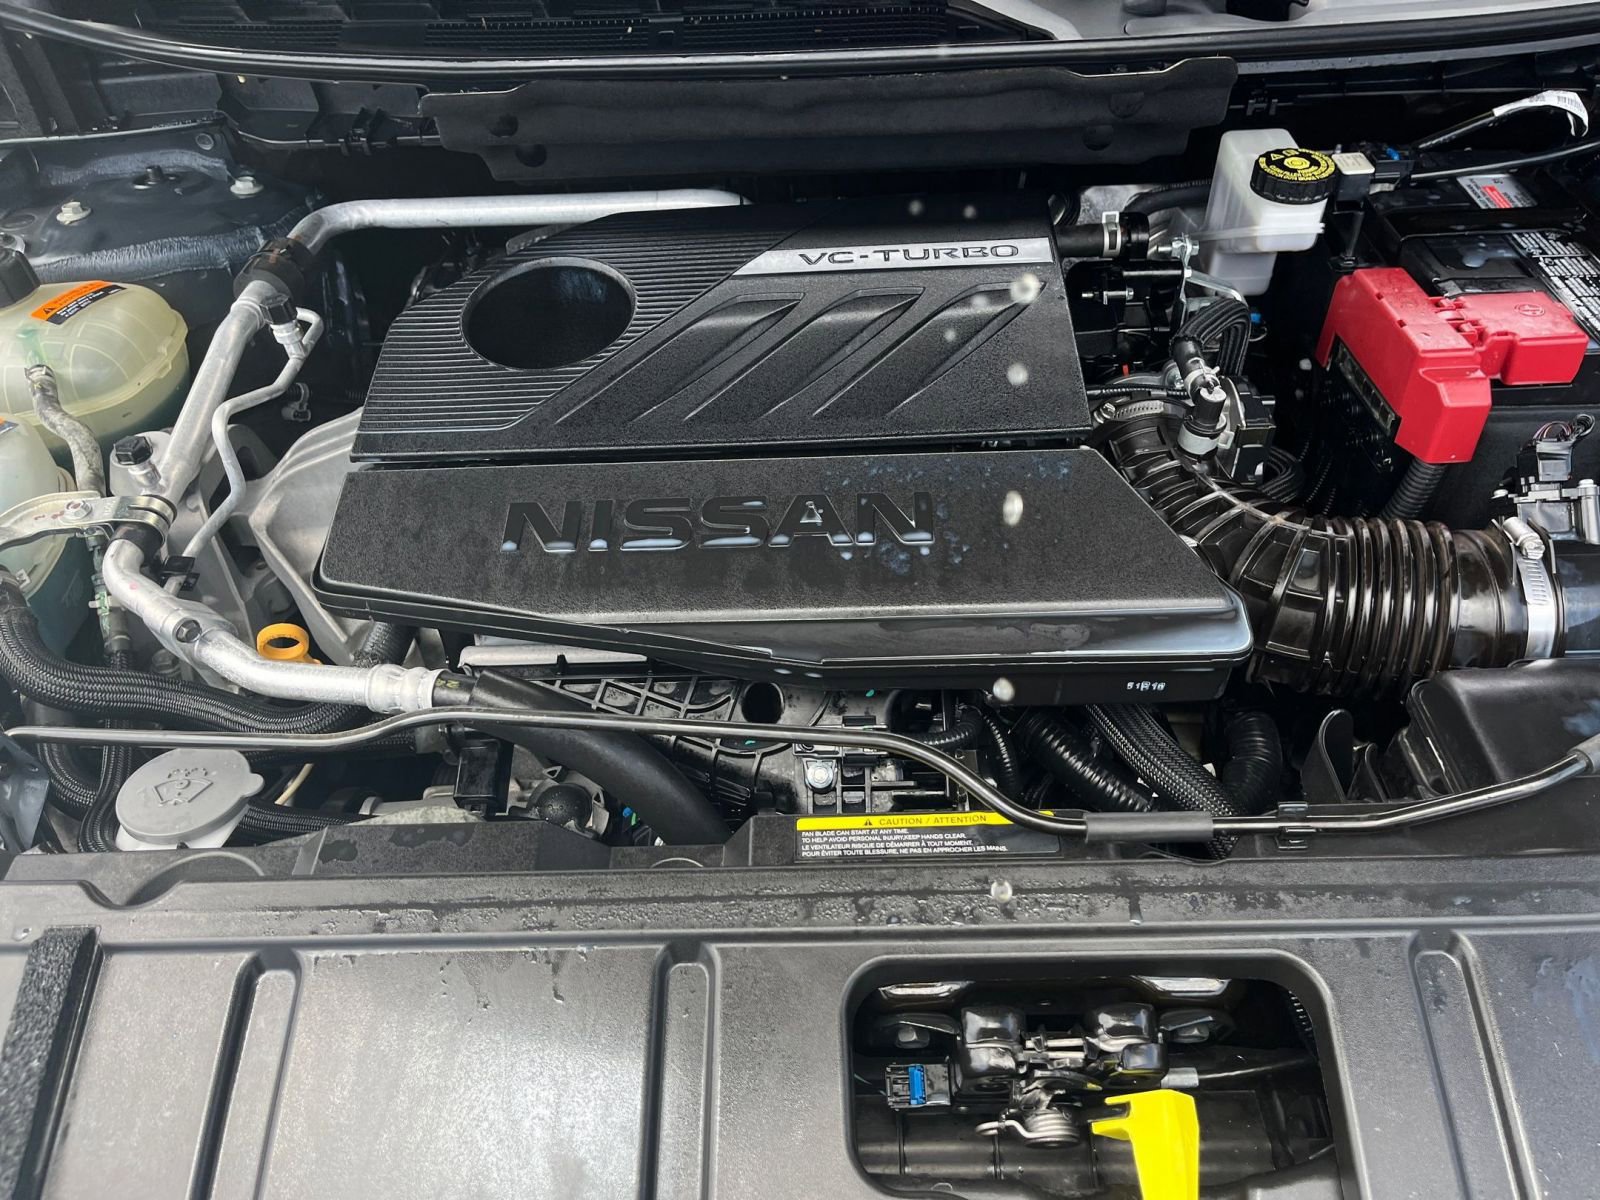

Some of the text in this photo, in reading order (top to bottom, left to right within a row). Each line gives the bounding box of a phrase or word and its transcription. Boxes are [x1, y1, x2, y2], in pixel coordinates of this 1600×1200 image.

[798, 244, 1020, 266] VC-TURBO
[500, 491, 936, 552] NISSAN
[879, 818, 923, 826] CAUTION
[934, 815, 987, 824] ATTENTION
[886, 840, 920, 848] DÉMARRER
